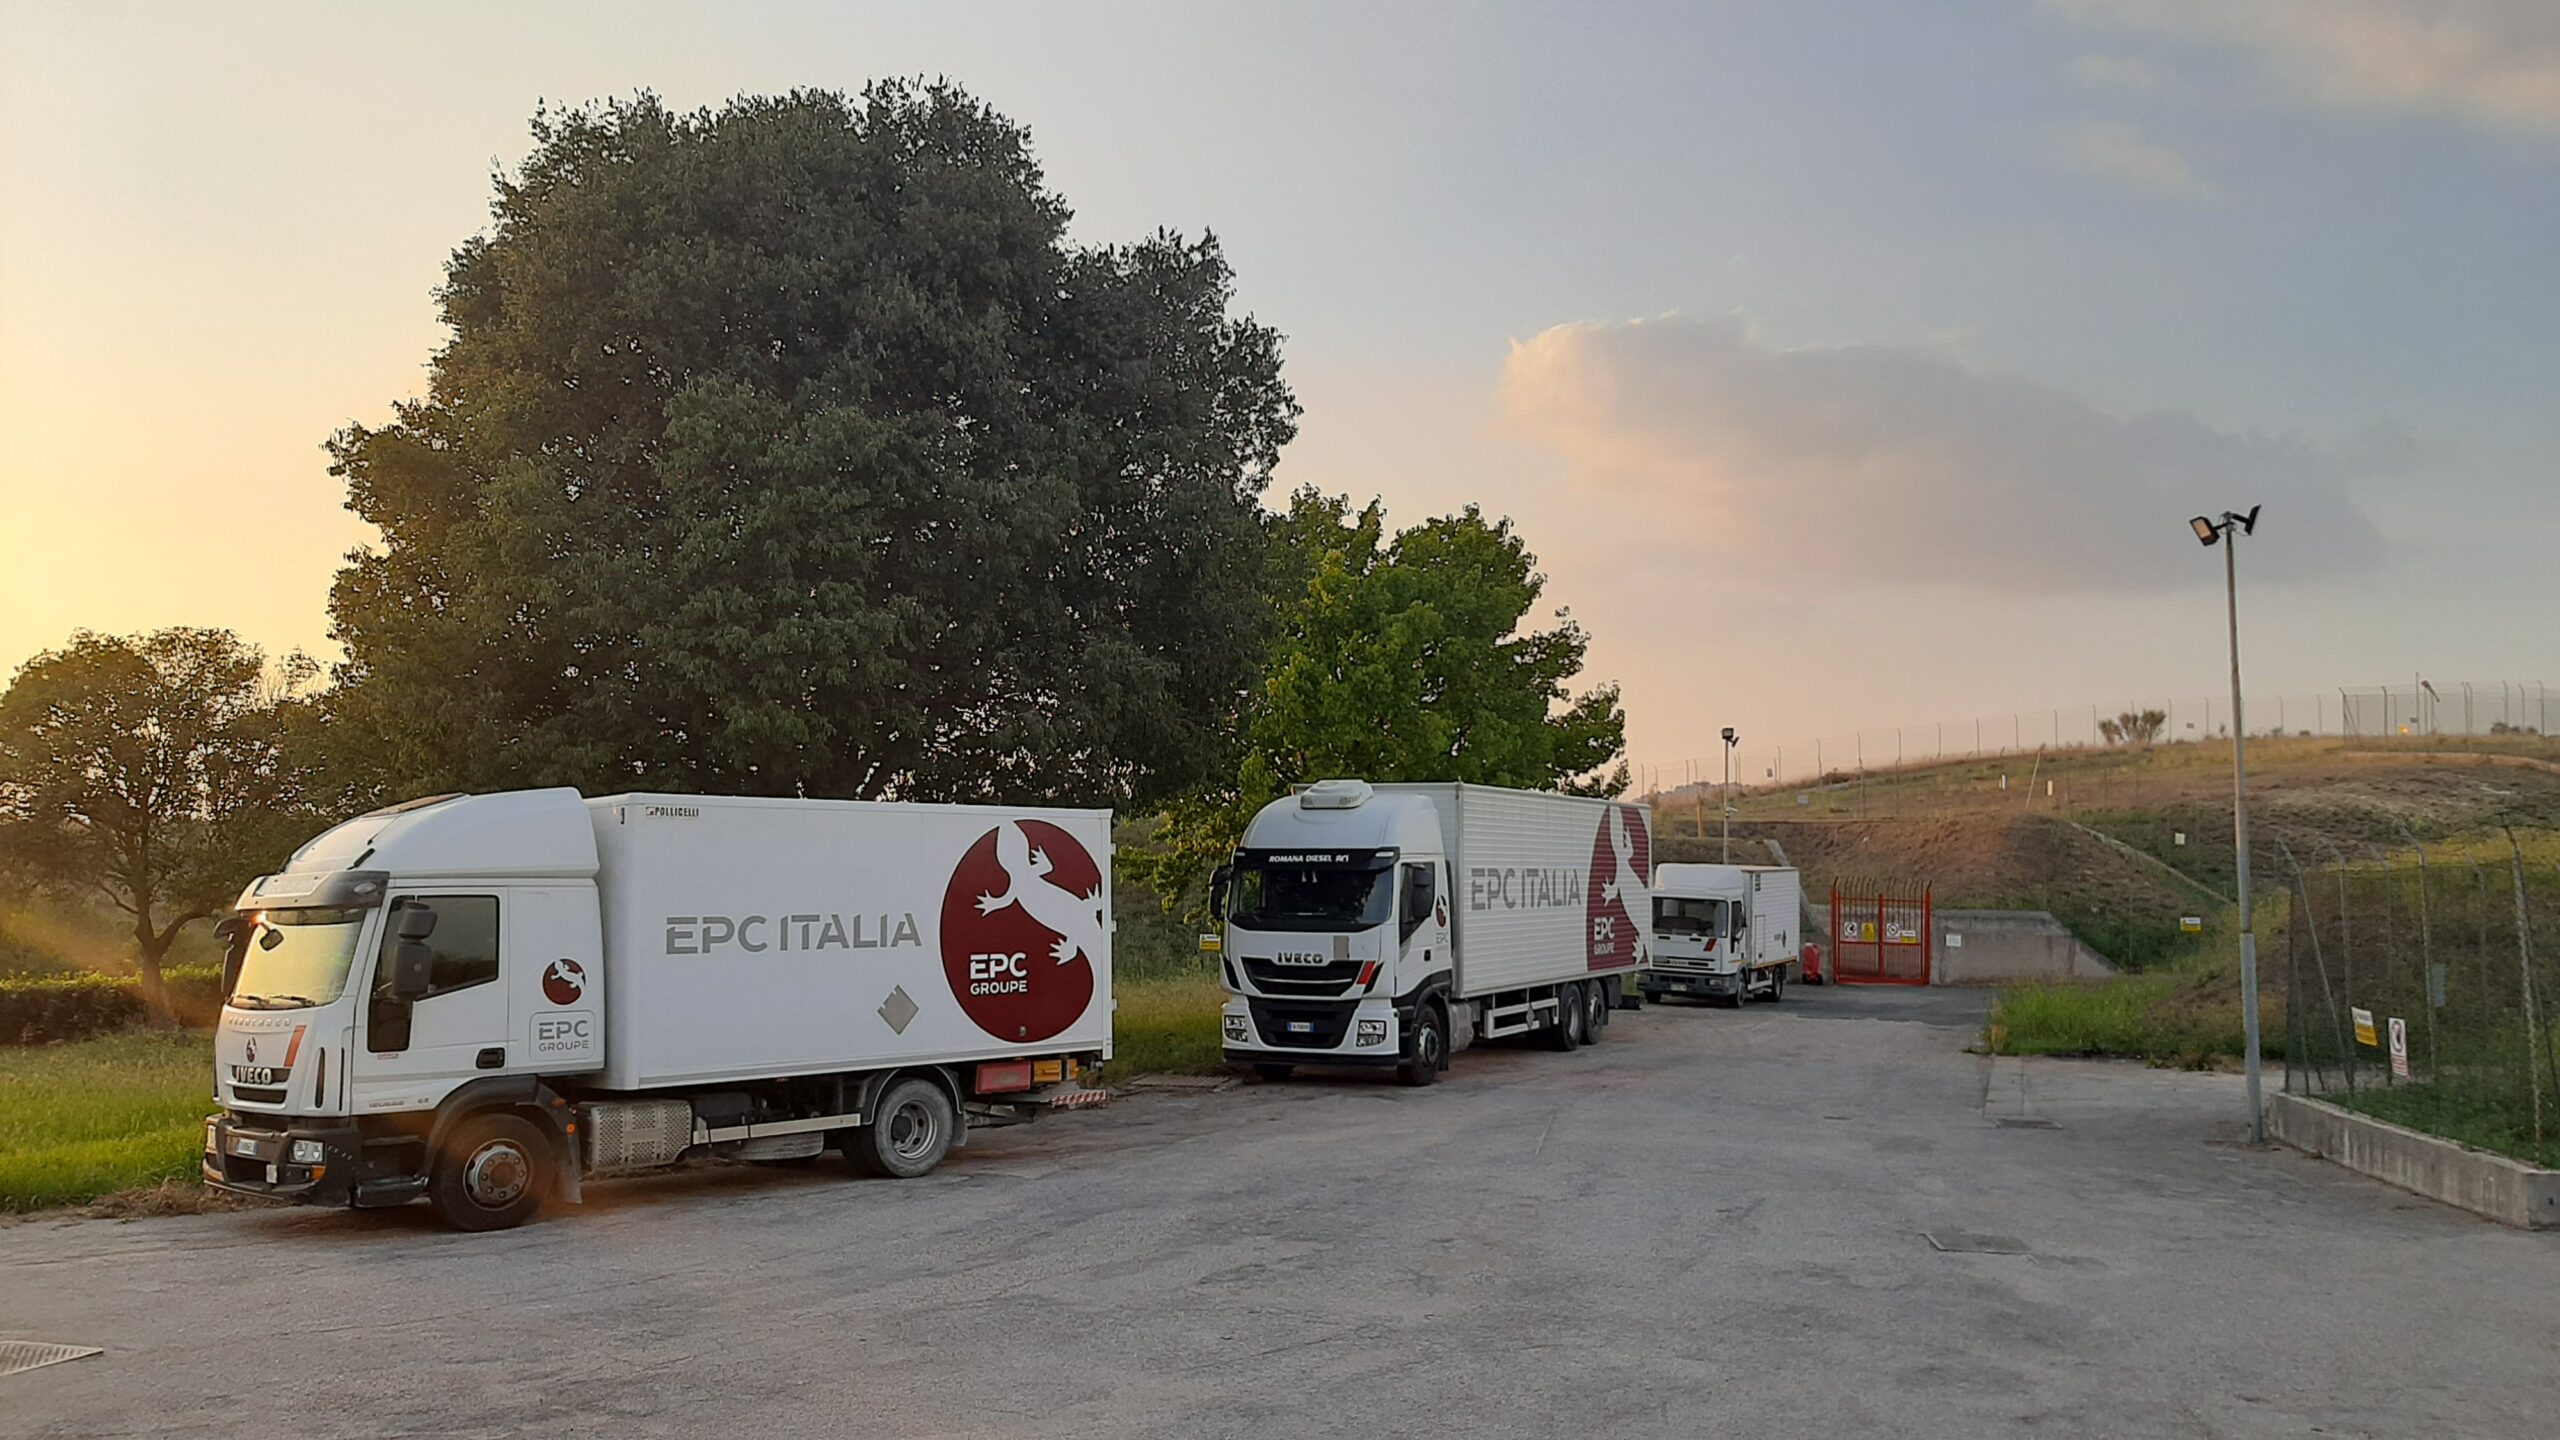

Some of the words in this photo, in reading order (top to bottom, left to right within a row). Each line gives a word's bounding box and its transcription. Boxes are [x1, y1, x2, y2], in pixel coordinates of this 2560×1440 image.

[654, 806, 700, 817] POLLICELLI
[1269, 855, 1304, 863] ROMANA
[1305, 854, 1333, 863] DIESEL
[1471, 868, 1516, 910] EPC
[1521, 868, 1581, 908] ITALIA
[666, 915, 768, 954] EPC
[779, 912, 922, 951] ITALIA
[1594, 917, 1615, 940] EPC
[970, 952, 1027, 979] EPC
[1278, 952, 1323, 963] IVECO
[970, 980, 1027, 995] GROUPE
[539, 1020, 588, 1040] EPC
[539, 1040, 589, 1052] GROUPE
[236, 1066, 272, 1085] IVECO
